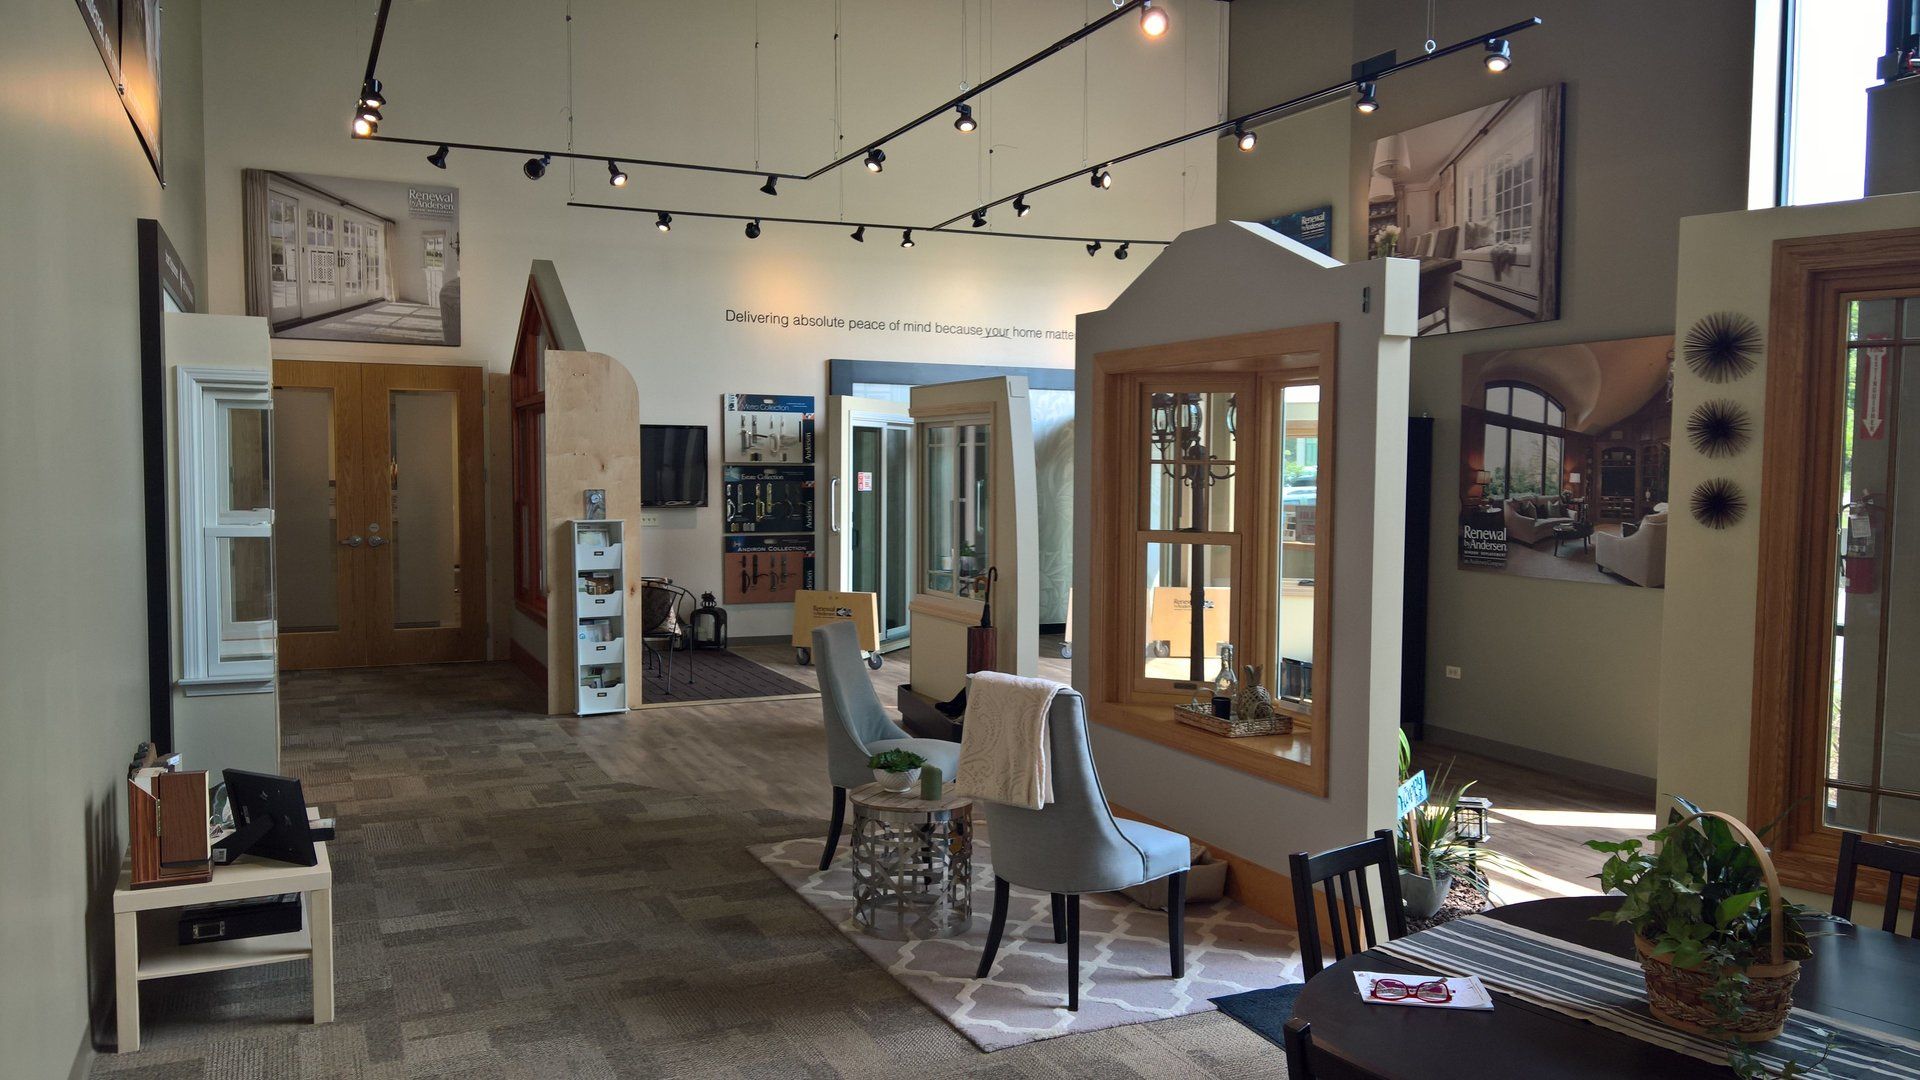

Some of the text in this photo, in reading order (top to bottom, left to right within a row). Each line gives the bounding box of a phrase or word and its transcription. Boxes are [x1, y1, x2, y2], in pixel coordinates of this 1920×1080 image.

[409, 189, 453, 203] Renewal
[416, 199, 454, 210] Andersen
[1301, 212, 1325, 225] Renewal
[725, 309, 1075, 340] Delivering absolute peace of mind because your home matte
[760, 403, 789, 411] Collection
[804, 432, 812, 461] Andersen
[805, 500, 813, 529] Andersen
[1464, 525, 1507, 541] Renewal
[1470, 540, 1507, 552] Andersen
